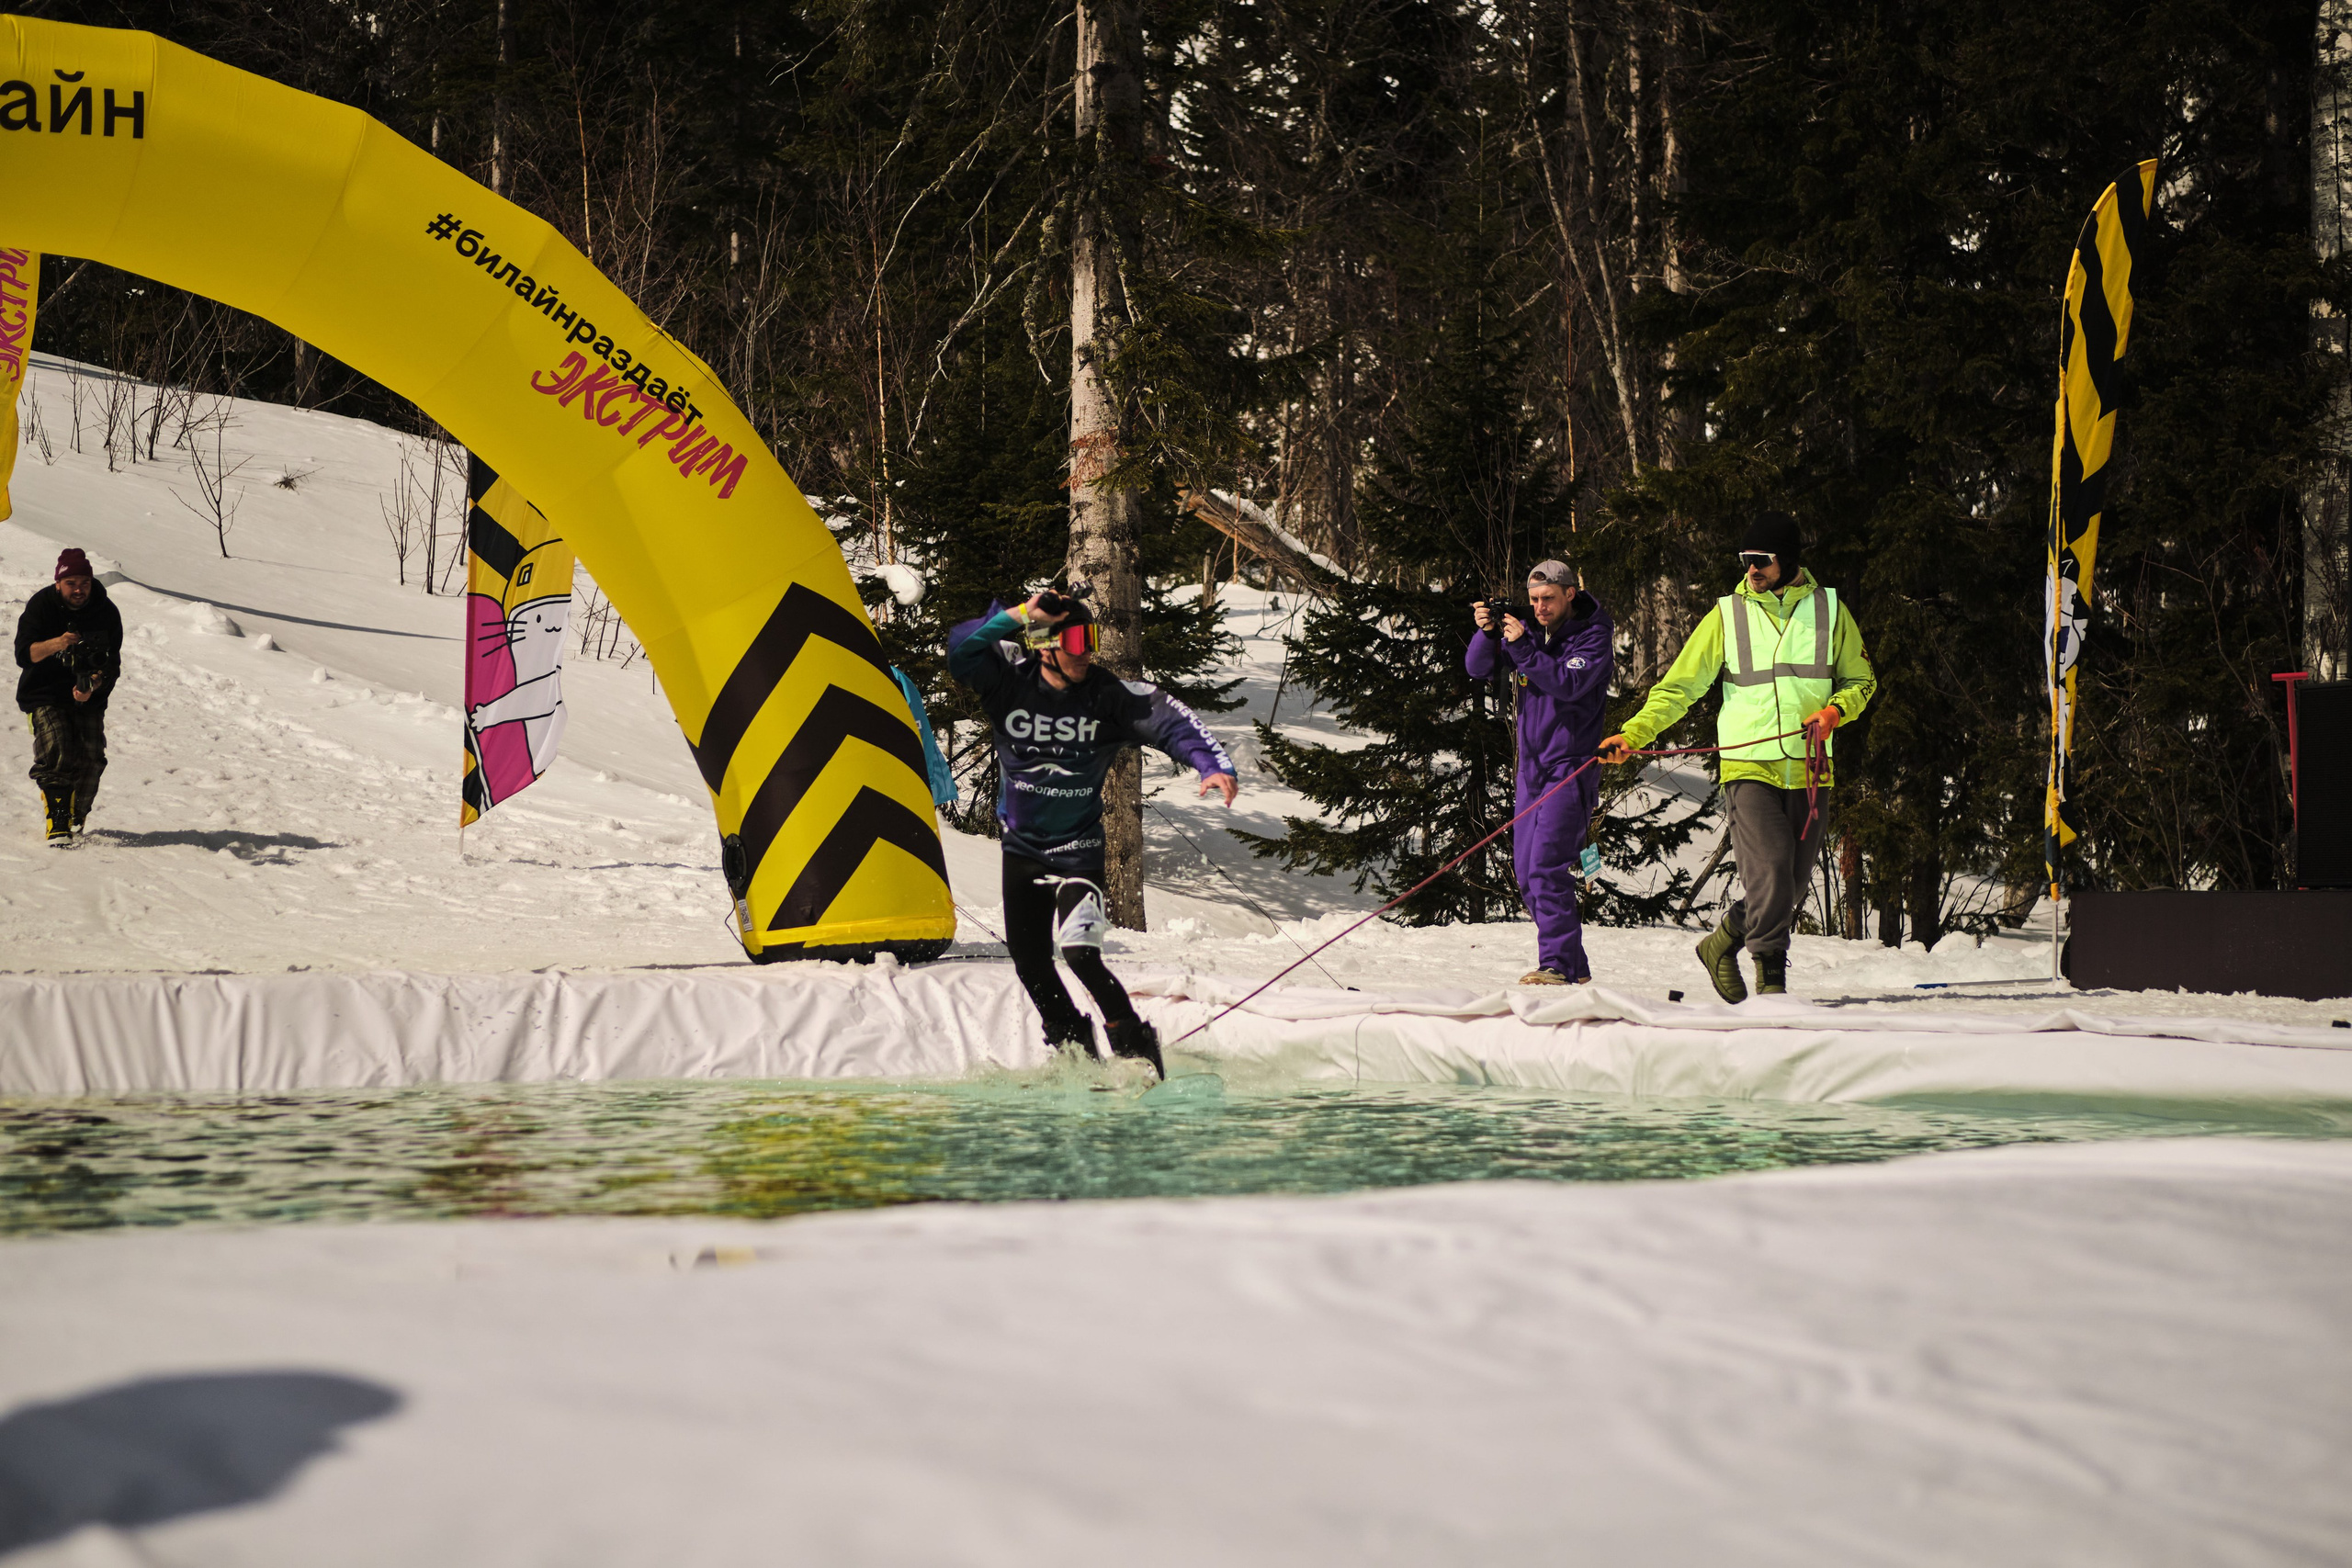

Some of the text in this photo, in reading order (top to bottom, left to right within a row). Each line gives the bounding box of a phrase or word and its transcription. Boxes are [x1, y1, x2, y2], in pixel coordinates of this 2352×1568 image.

[0, 69, 144, 140] айн
[425, 212, 704, 426] #билайнраздаёт
[530, 350, 749, 500] ЭКСТРИМ
[1005, 708, 1101, 742] GESH
